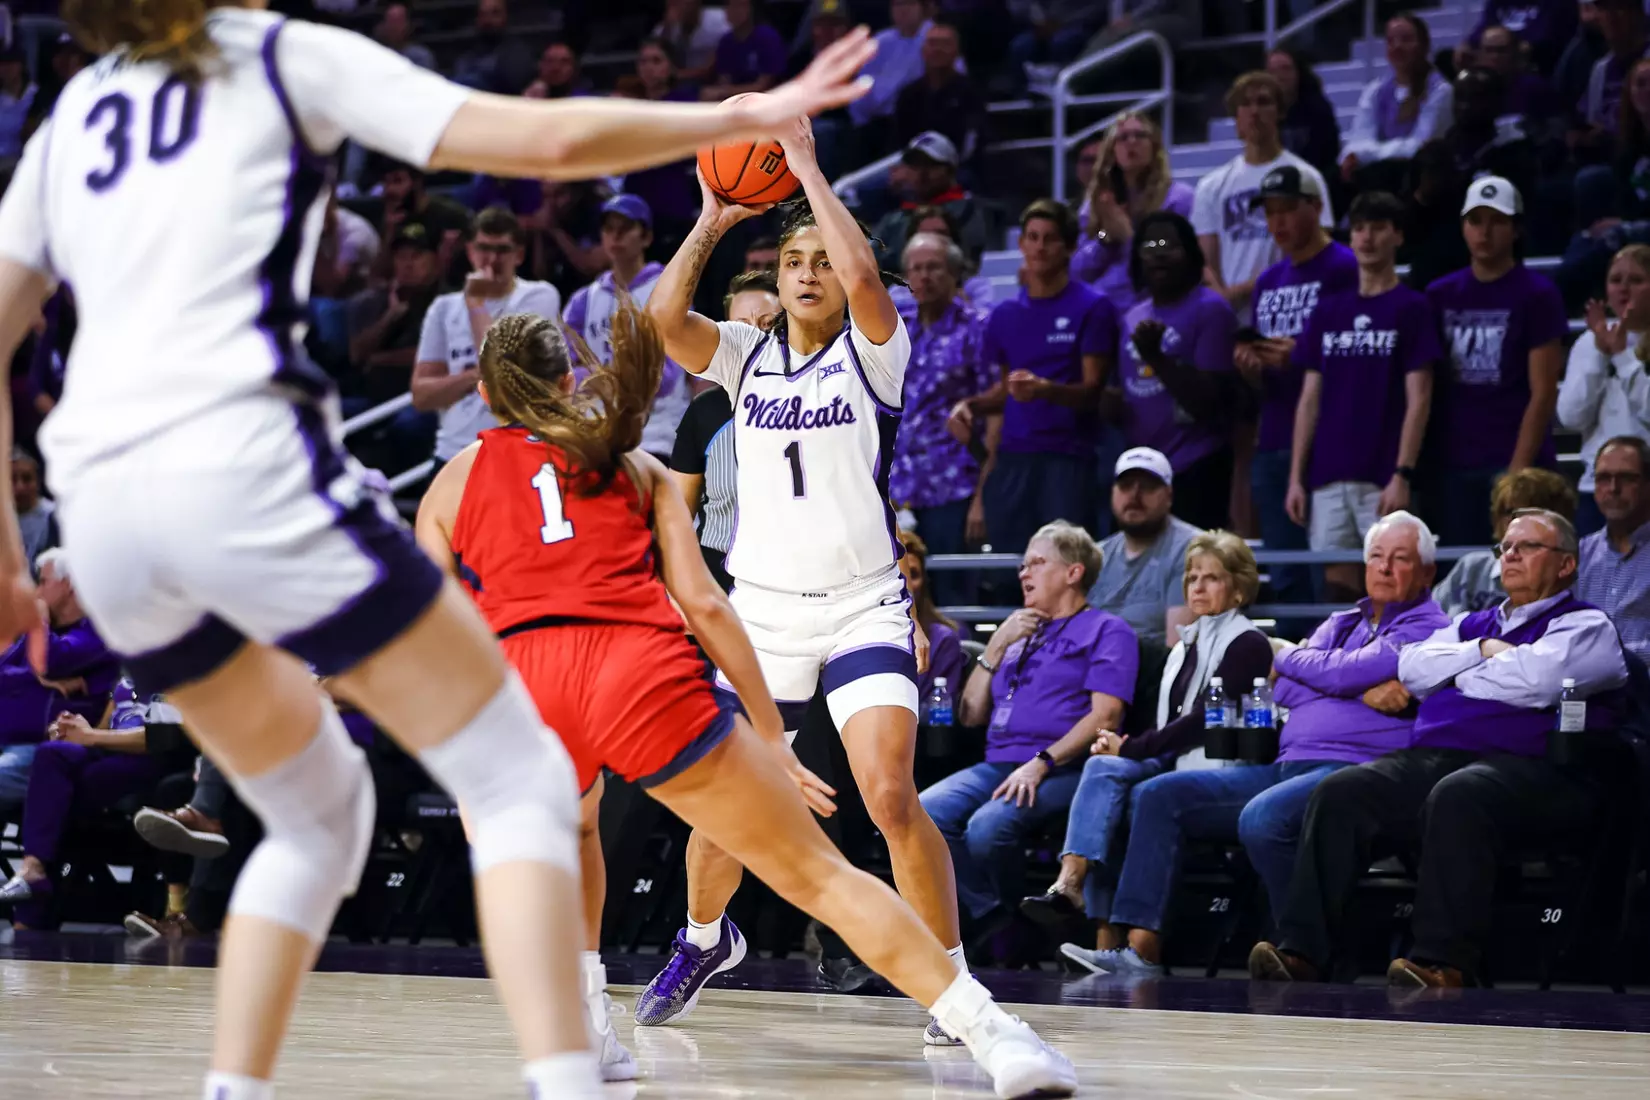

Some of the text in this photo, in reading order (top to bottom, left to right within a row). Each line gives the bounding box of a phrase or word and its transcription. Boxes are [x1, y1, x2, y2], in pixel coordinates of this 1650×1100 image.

[84, 72, 203, 193] 30
[743, 393, 857, 430] Wildcats
[783, 440, 807, 500] 1
[530, 461, 576, 546] 1
[385, 871, 405, 887] 22
[633, 878, 653, 894] 24
[1209, 897, 1231, 912] 28
[1540, 908, 1562, 923] 30
